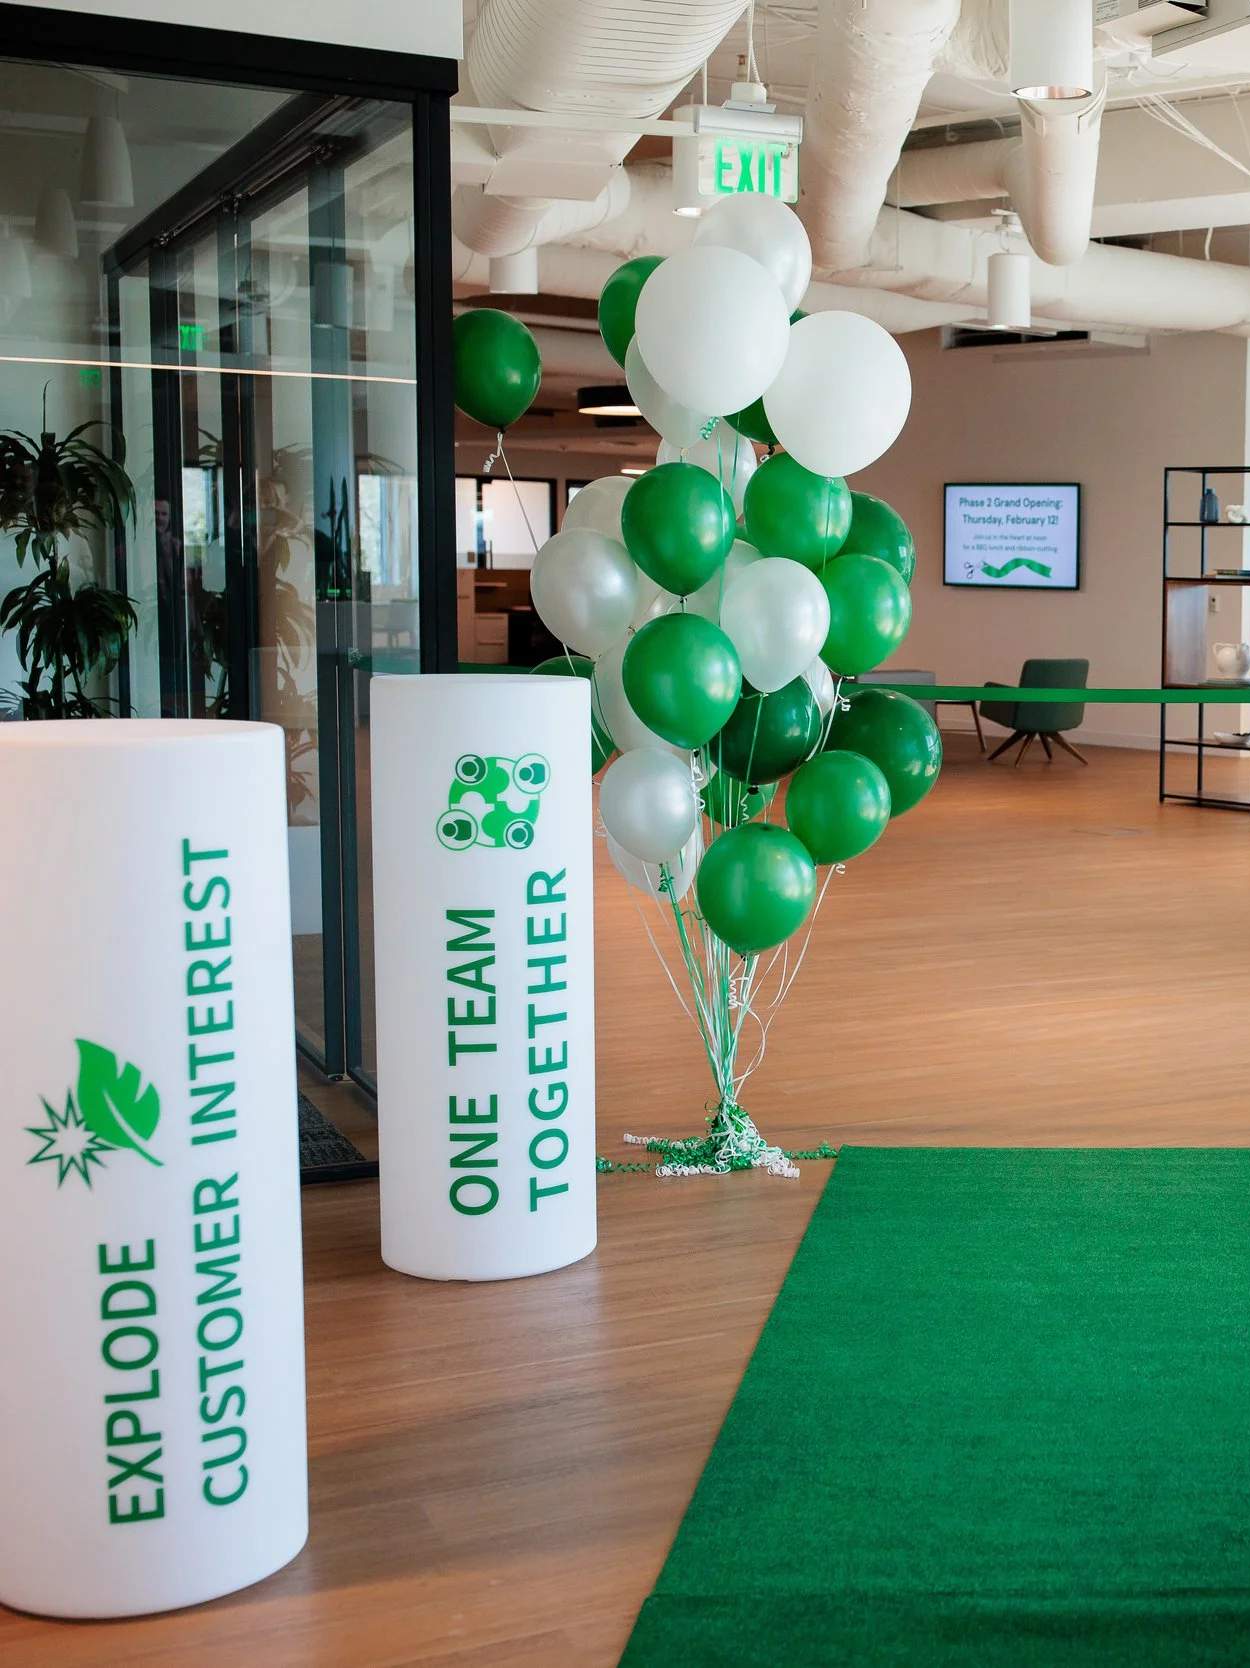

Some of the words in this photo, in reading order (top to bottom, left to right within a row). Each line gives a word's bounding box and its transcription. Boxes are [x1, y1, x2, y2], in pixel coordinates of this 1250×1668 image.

[714, 138, 788, 198] EXIT
[959, 497, 985, 508] Phase
[986, 498, 993, 508] 2
[994, 498, 1021, 508] Grand
[1023, 498, 1063, 511] Opening:
[962, 514, 1004, 527] Thursday,
[1006, 515, 1045, 527] February
[1047, 515, 1059, 526] 12!
[181, 836, 239, 1146] INTEREST
[445, 907, 499, 1067] TEAM
[524, 866, 569, 1214] TOGETHER
[447, 1092, 500, 1216] ONE
[97, 1238, 166, 1525] EXPLODE
[191, 1171, 250, 1508] CUSTOMER
